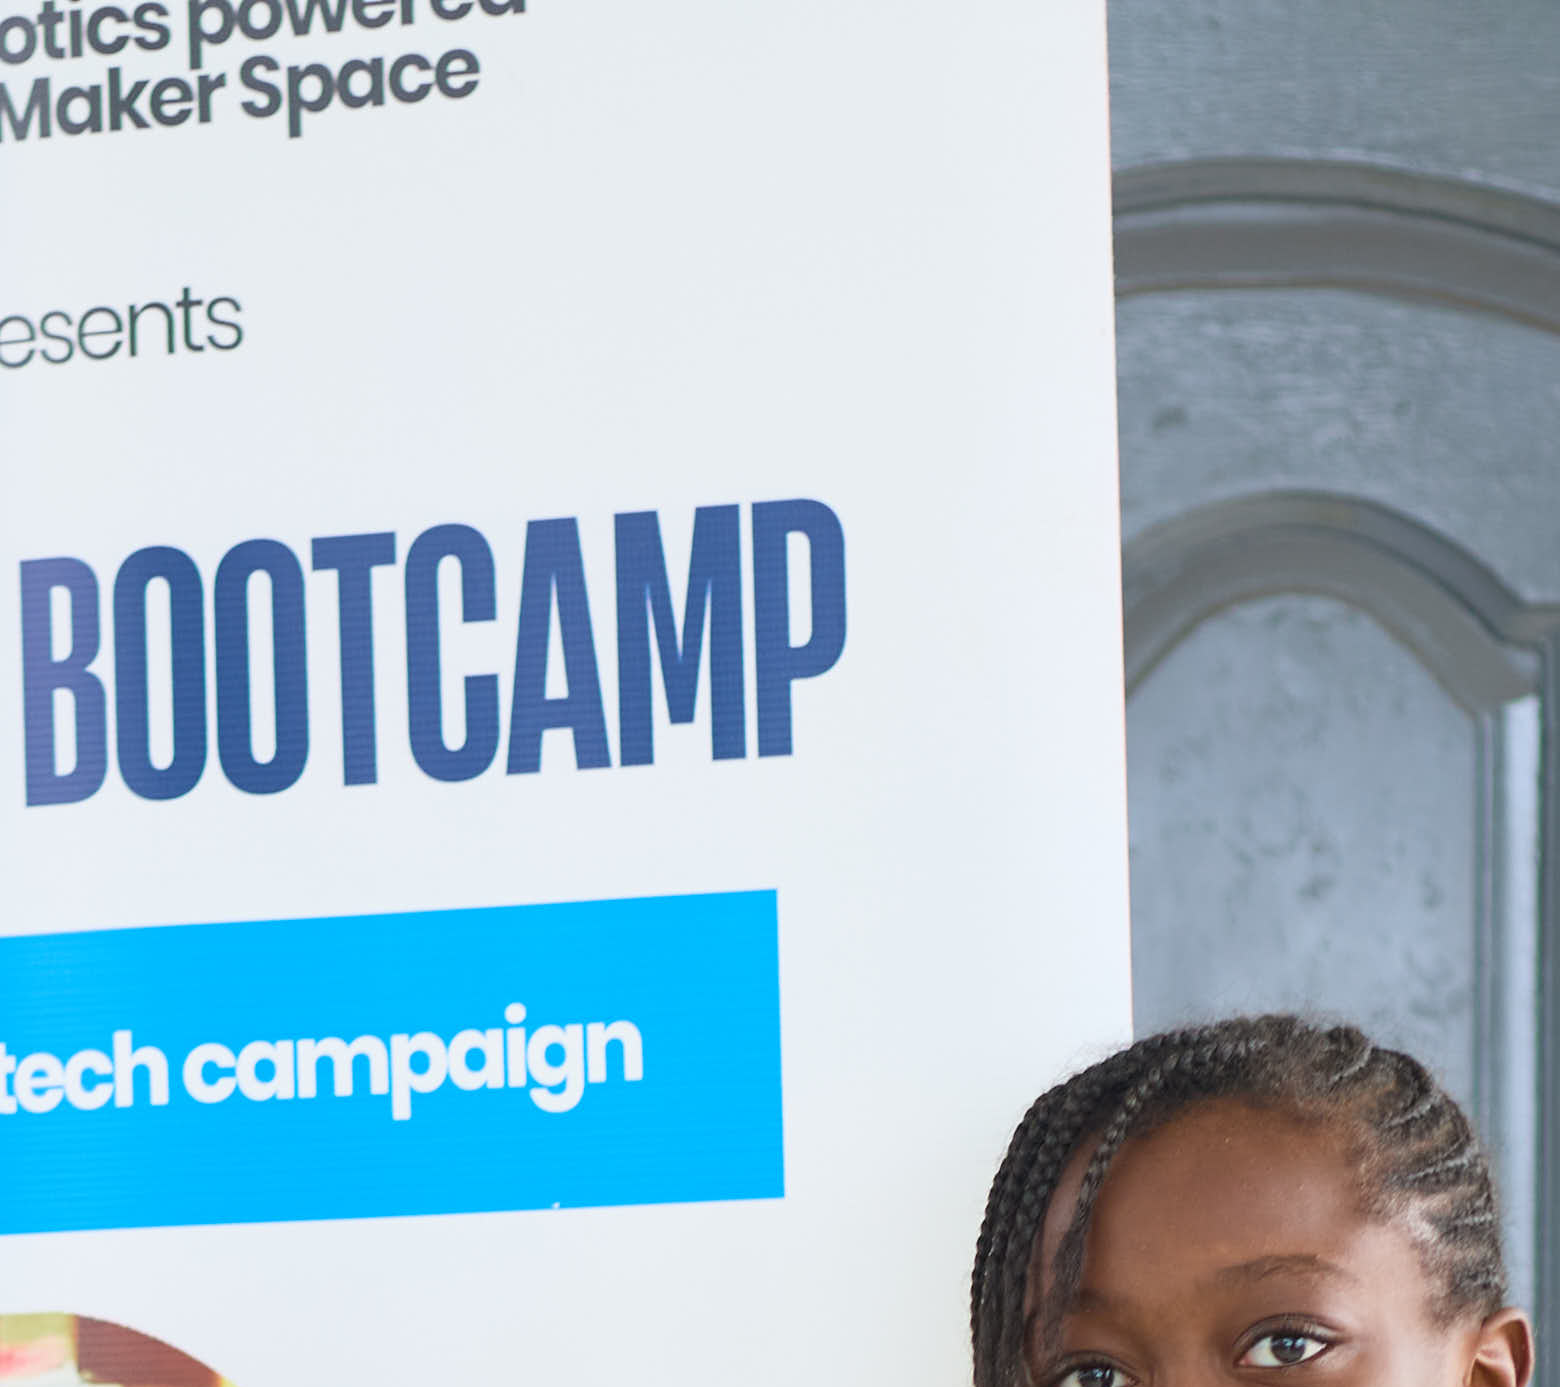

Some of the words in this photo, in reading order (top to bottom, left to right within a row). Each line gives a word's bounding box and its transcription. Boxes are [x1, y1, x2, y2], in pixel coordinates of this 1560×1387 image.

[188, 0, 527, 70] powe
[240, 48, 481, 139] Space
[18, 497, 848, 809] BOOTCAMP
[182, 1002, 644, 1121] campaign
